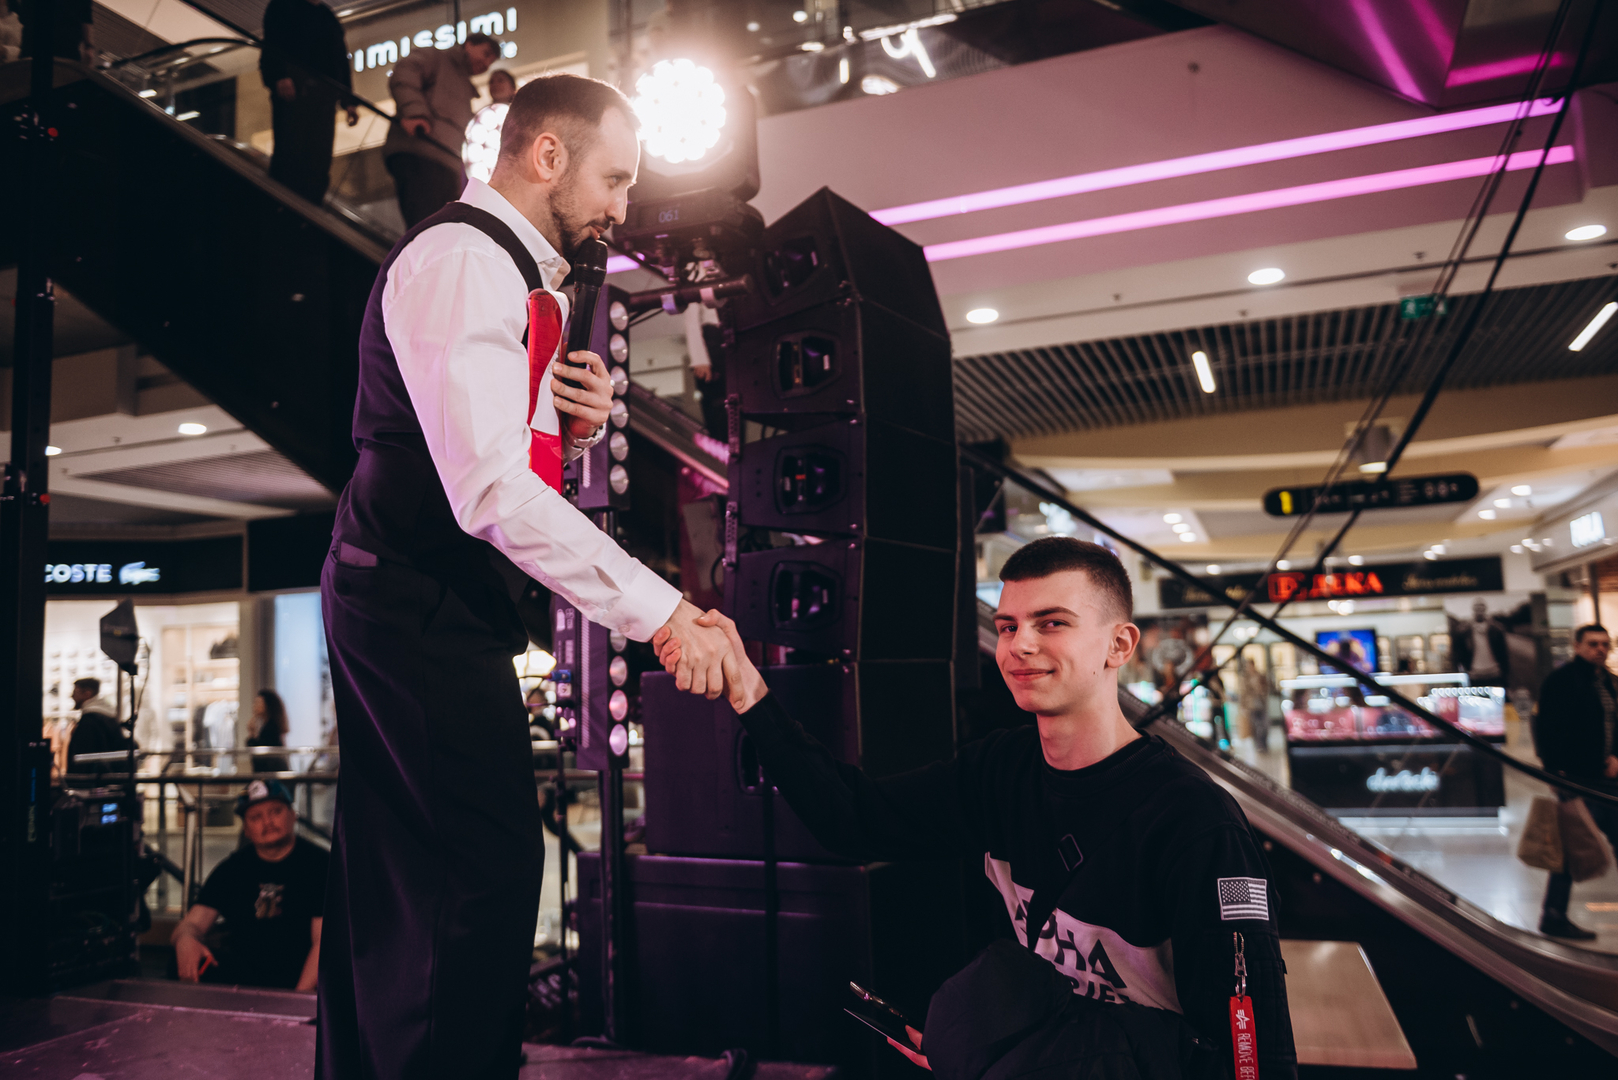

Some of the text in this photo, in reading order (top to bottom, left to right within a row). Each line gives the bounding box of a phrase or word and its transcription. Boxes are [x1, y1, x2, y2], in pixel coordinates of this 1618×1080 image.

[347, 7, 518, 73] imissimi
[658, 210, 679, 223] 061
[1237, 1033, 1256, 1080] REMOVE BEF
